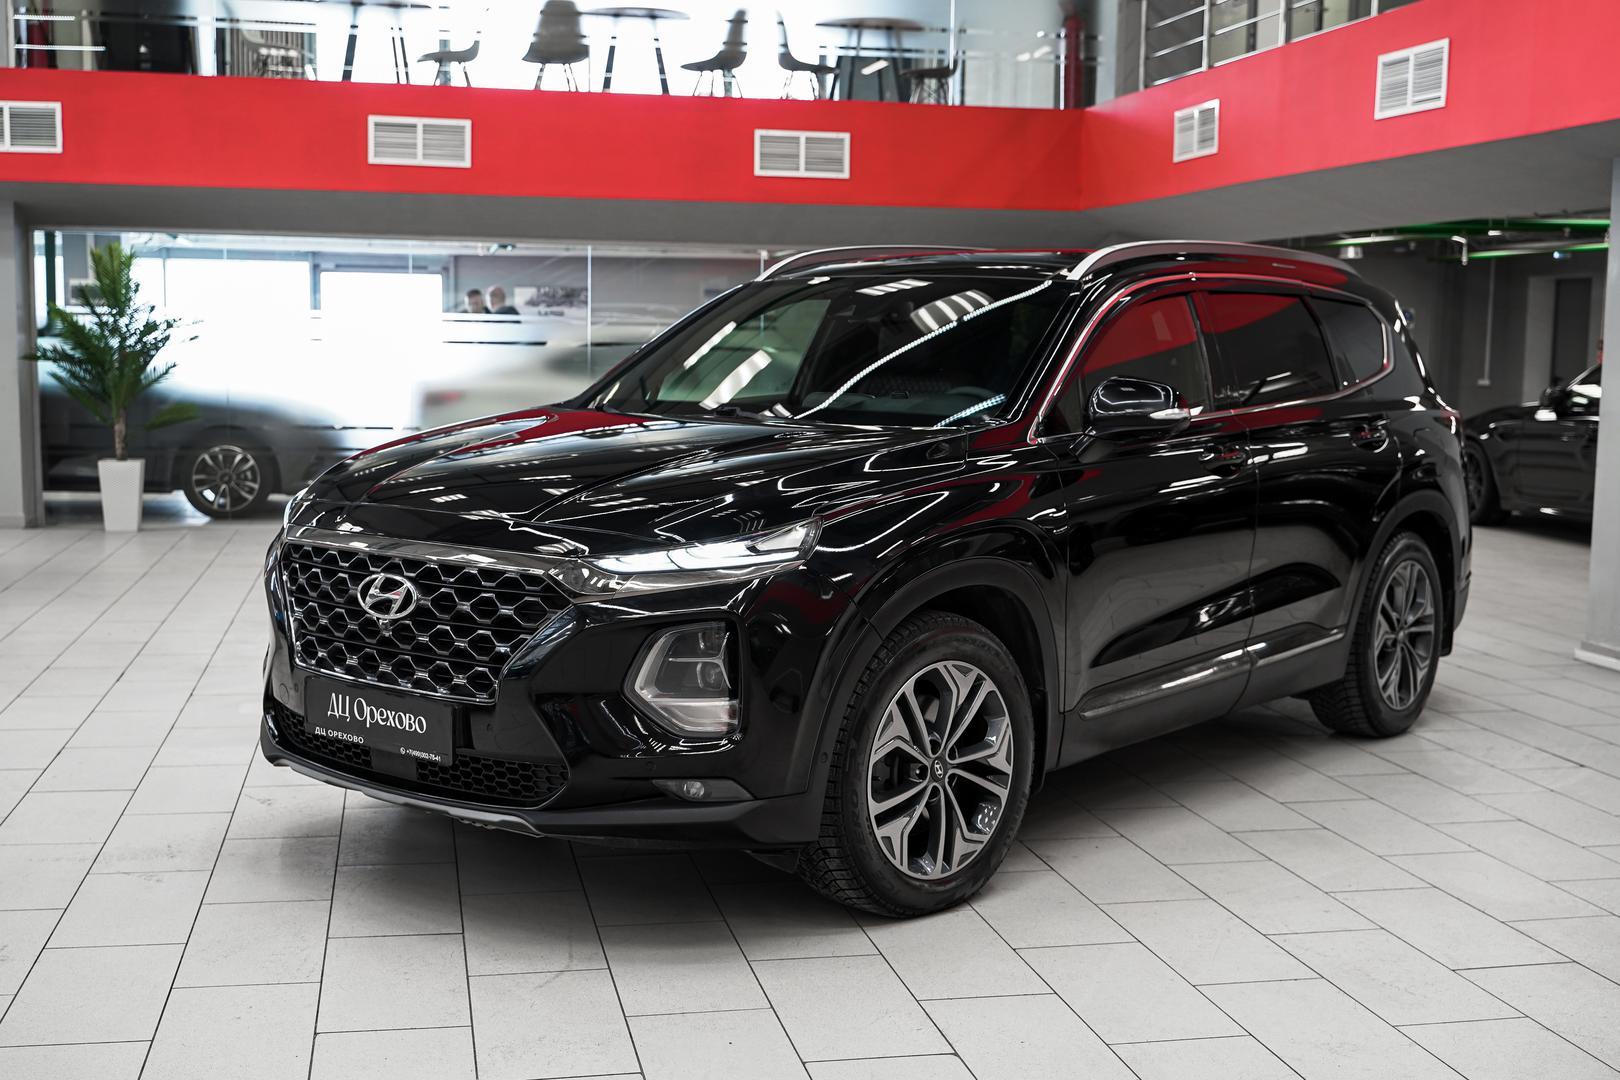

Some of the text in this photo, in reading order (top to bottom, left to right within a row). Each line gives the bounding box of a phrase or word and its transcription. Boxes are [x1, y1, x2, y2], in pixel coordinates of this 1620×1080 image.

[327, 692, 427, 734] ДЦ Орехово
[314, 726, 364, 744] ДЦ ОРЕХОВО
